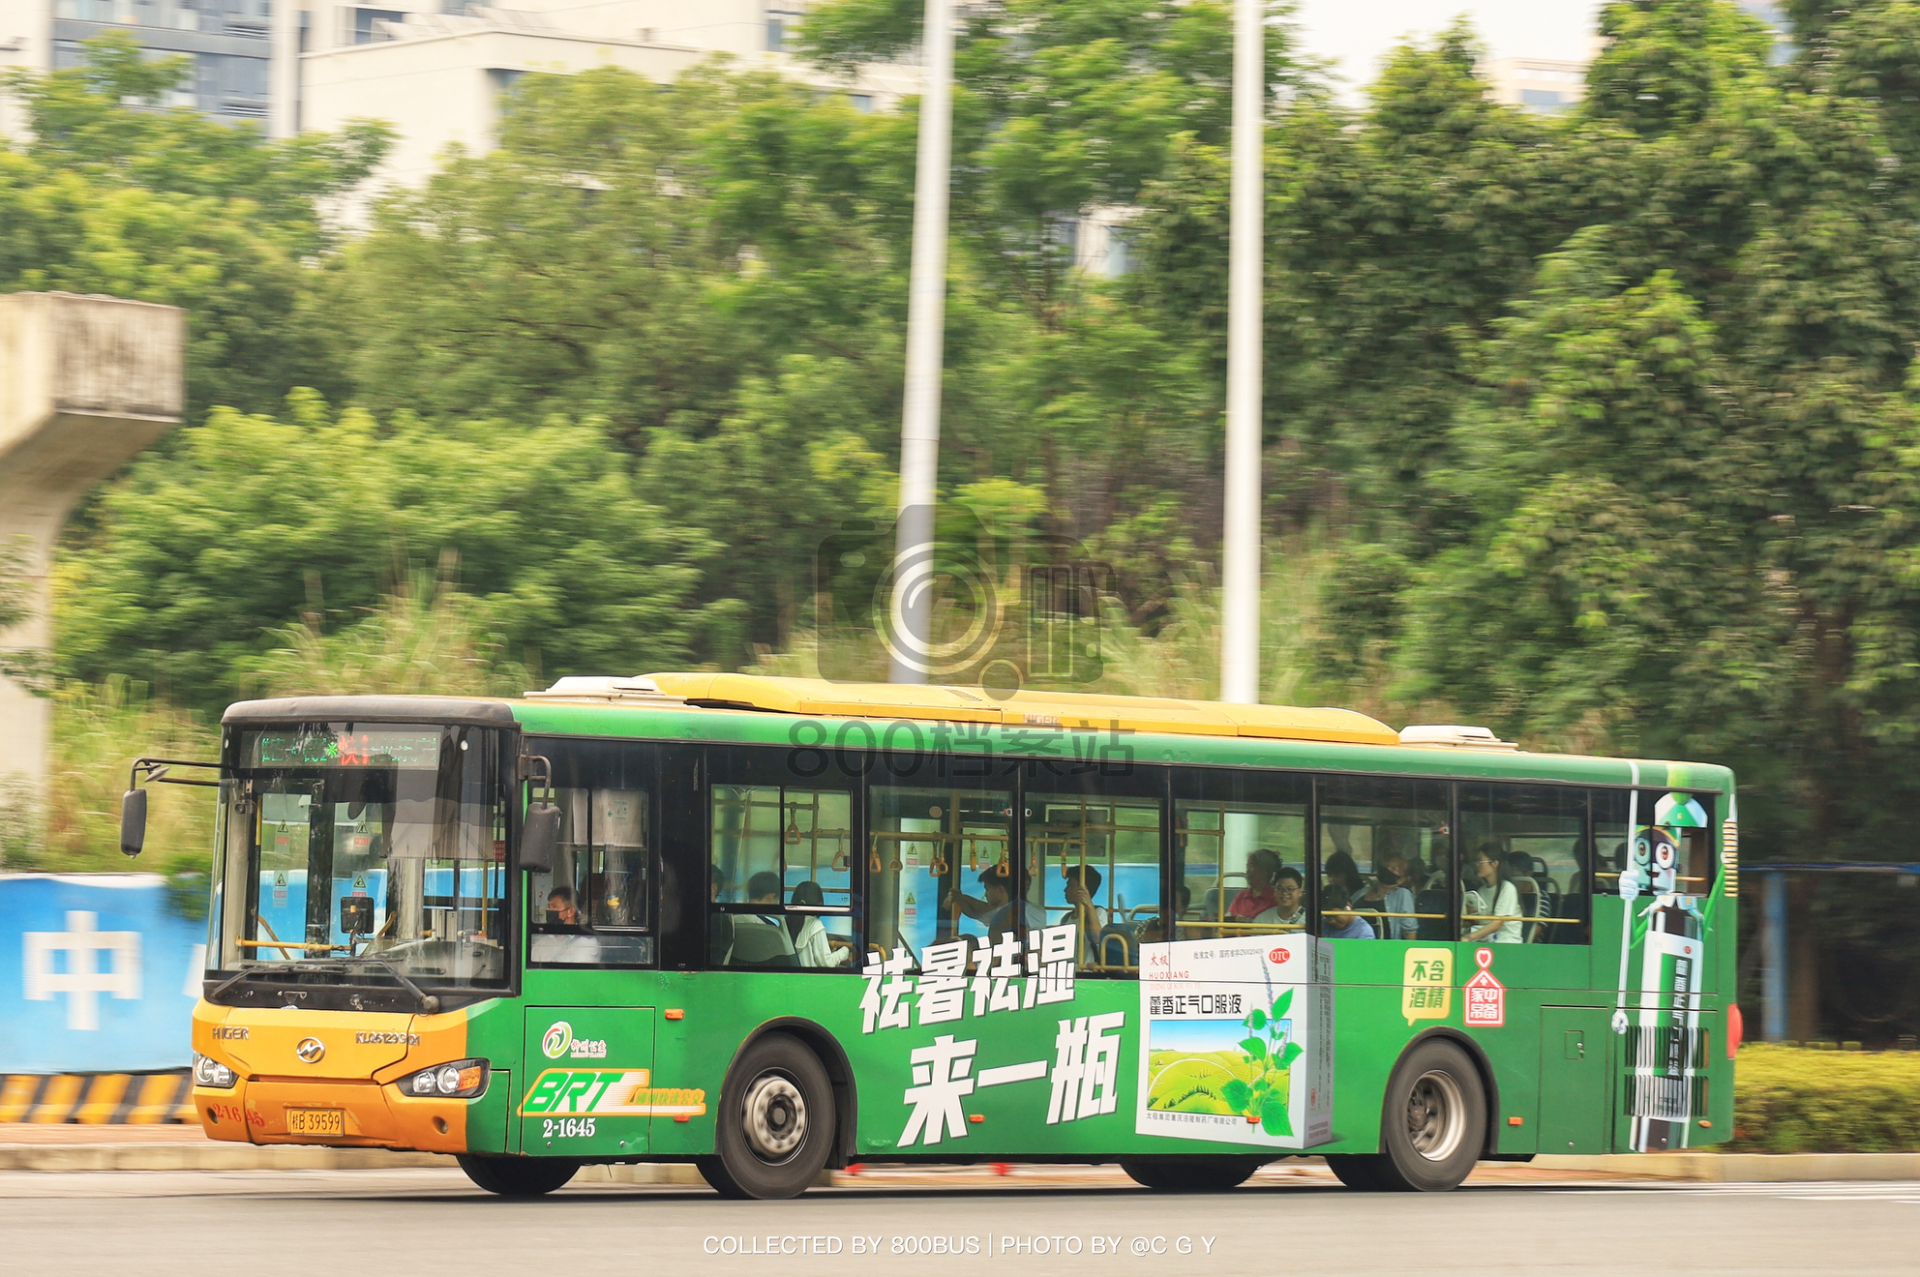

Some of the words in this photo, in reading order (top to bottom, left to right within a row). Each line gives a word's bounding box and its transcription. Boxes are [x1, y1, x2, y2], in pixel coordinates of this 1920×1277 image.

[1269, 950, 1290, 961] OTC
[858, 923, 1077, 1034] 祛暑祛湿
[1149, 970, 1190, 979] HUOXIANG
[1411, 960, 1445, 981] 不含
[1150, 994, 1242, 1015] 藿香正气口服液
[1409, 987, 1445, 1008] 酒精
[1471, 988, 1498, 1002] 家中
[213, 1026, 249, 1040] HIGER
[897, 1010, 1125, 1148] 来一瓶
[523, 1072, 625, 1112] BRT
[542, 1118, 596, 1138] 2-1645
